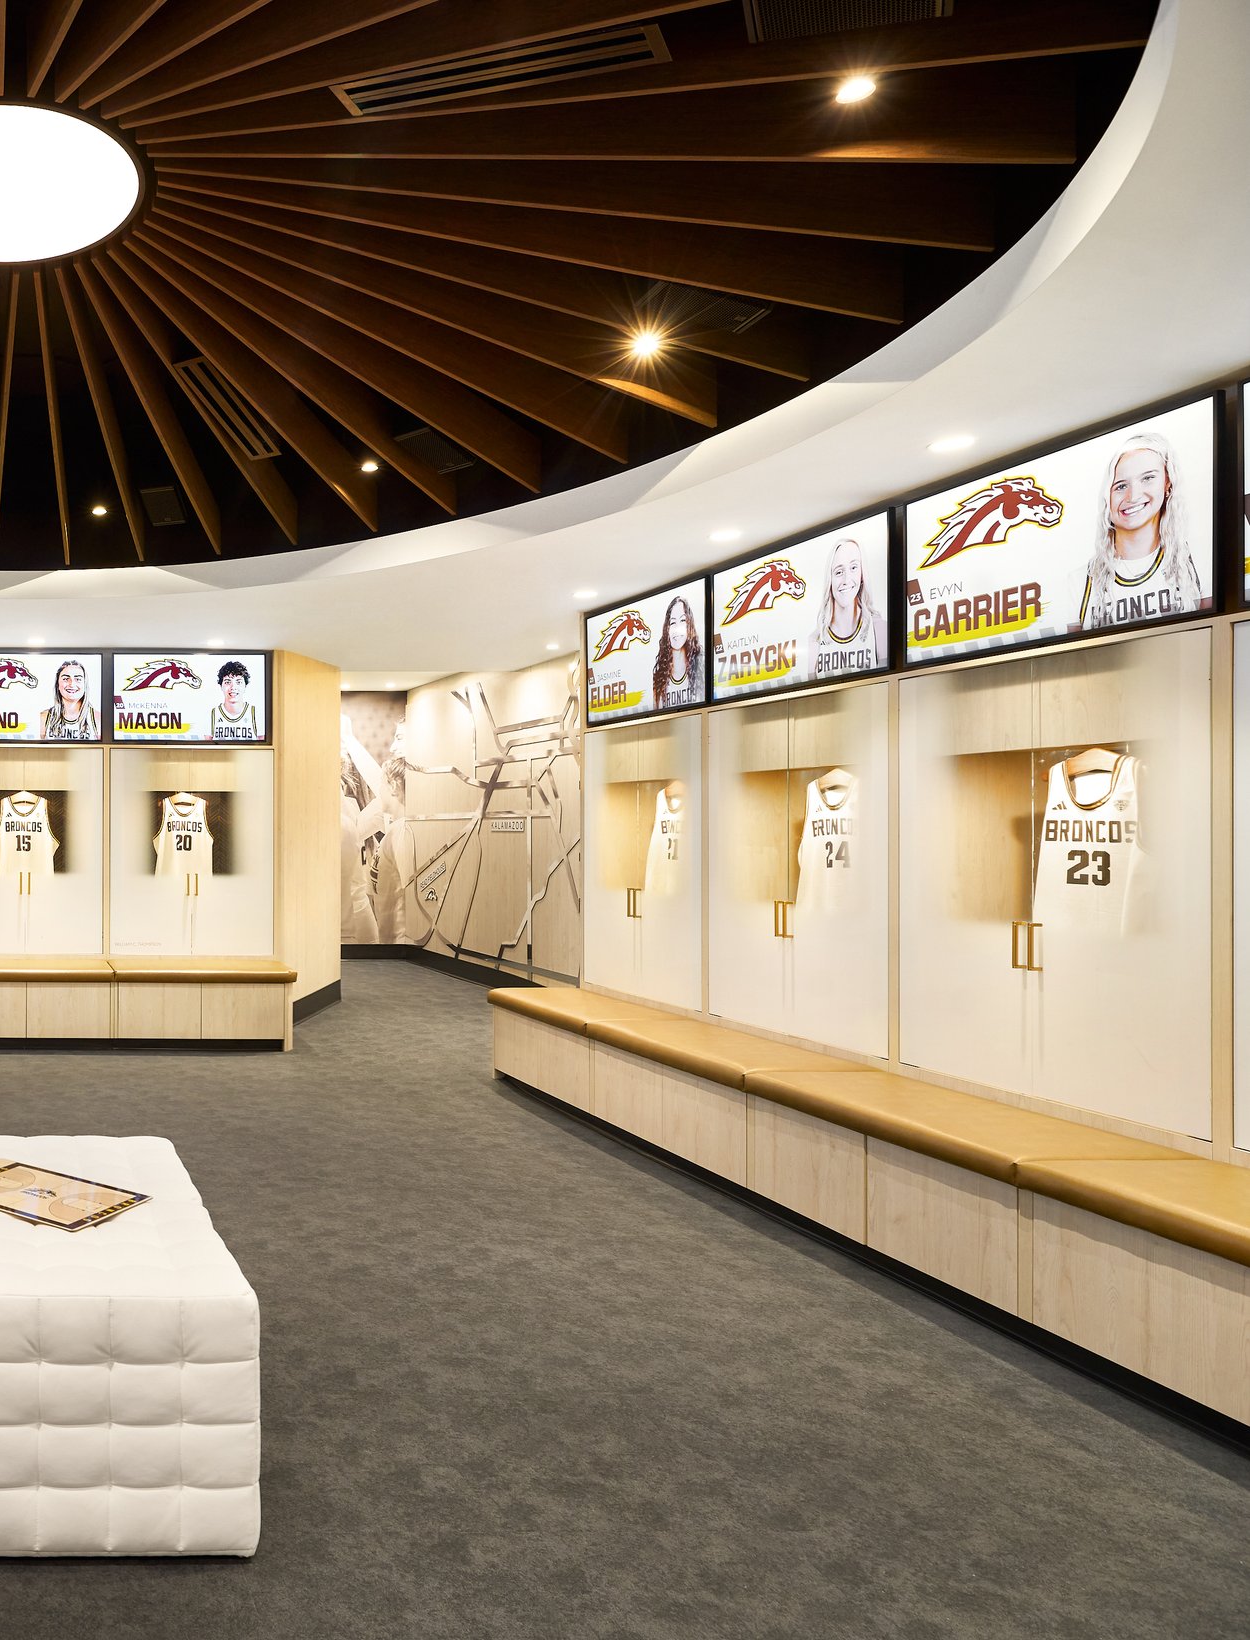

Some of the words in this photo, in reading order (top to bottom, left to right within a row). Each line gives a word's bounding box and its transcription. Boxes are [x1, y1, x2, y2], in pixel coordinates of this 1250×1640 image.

[908, 592, 922, 604] 23
[929, 581, 963, 600] EVYN
[913, 581, 1042, 642] CARRIER
[727, 634, 759, 650] KAITLYN
[718, 639, 797, 683] ZARYCKI
[817, 648, 872, 674] BRONCOS
[590, 680, 627, 709] ELDER
[118, 712, 182, 730] MACON
[48, 728, 91, 740] BONCOS
[215, 727, 253, 739] BRONCOS
[5, 821, 42, 833] BRONCOS
[167, 820, 202, 833] BRONCOS
[491, 821, 524, 831] KALAMAZOO
[811, 818, 853, 838] BRONCO
[1045, 819, 1137, 843] BRONCOS
[15, 834, 32, 852] 15
[175, 834, 192, 852] 20
[825, 841, 851, 868] 24
[1066, 849, 1111, 887] 23
